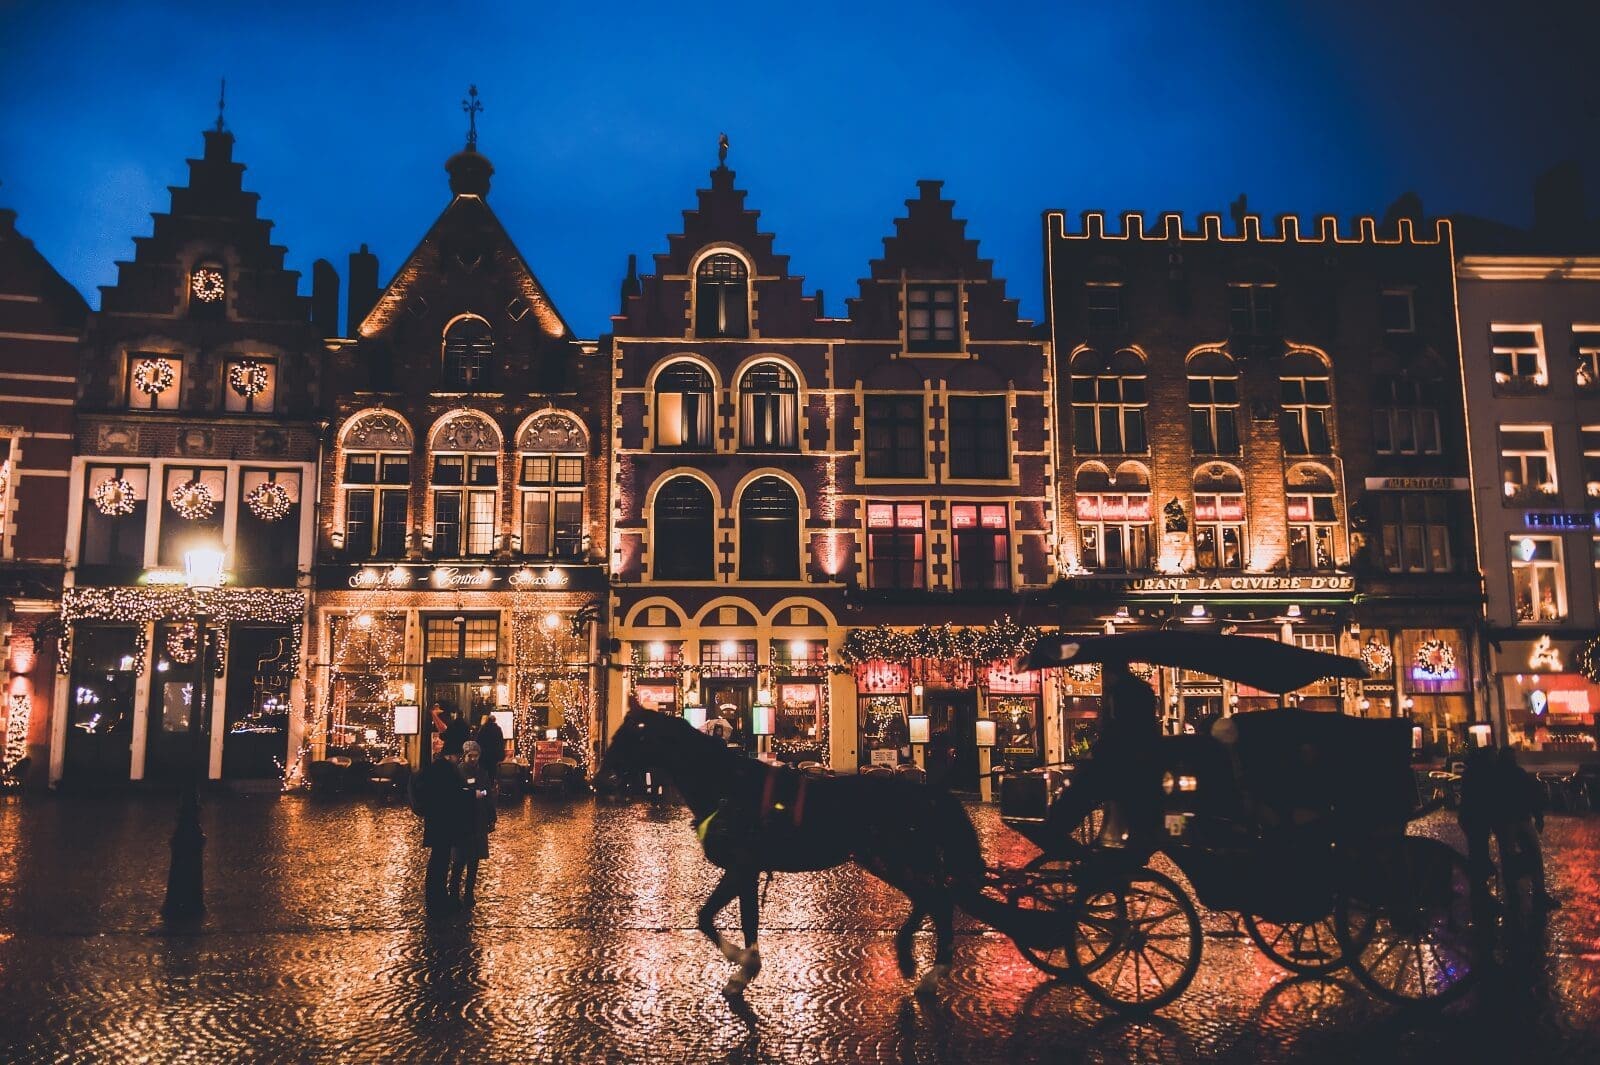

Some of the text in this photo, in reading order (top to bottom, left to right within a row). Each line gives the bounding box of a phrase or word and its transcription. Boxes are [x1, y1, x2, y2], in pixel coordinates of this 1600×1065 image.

[509, 570, 569, 585] Brassie
[1198, 577, 1221, 590] LA
[1231, 577, 1300, 590] CIVIERE
[1311, 576, 1351, 589] D'OR
